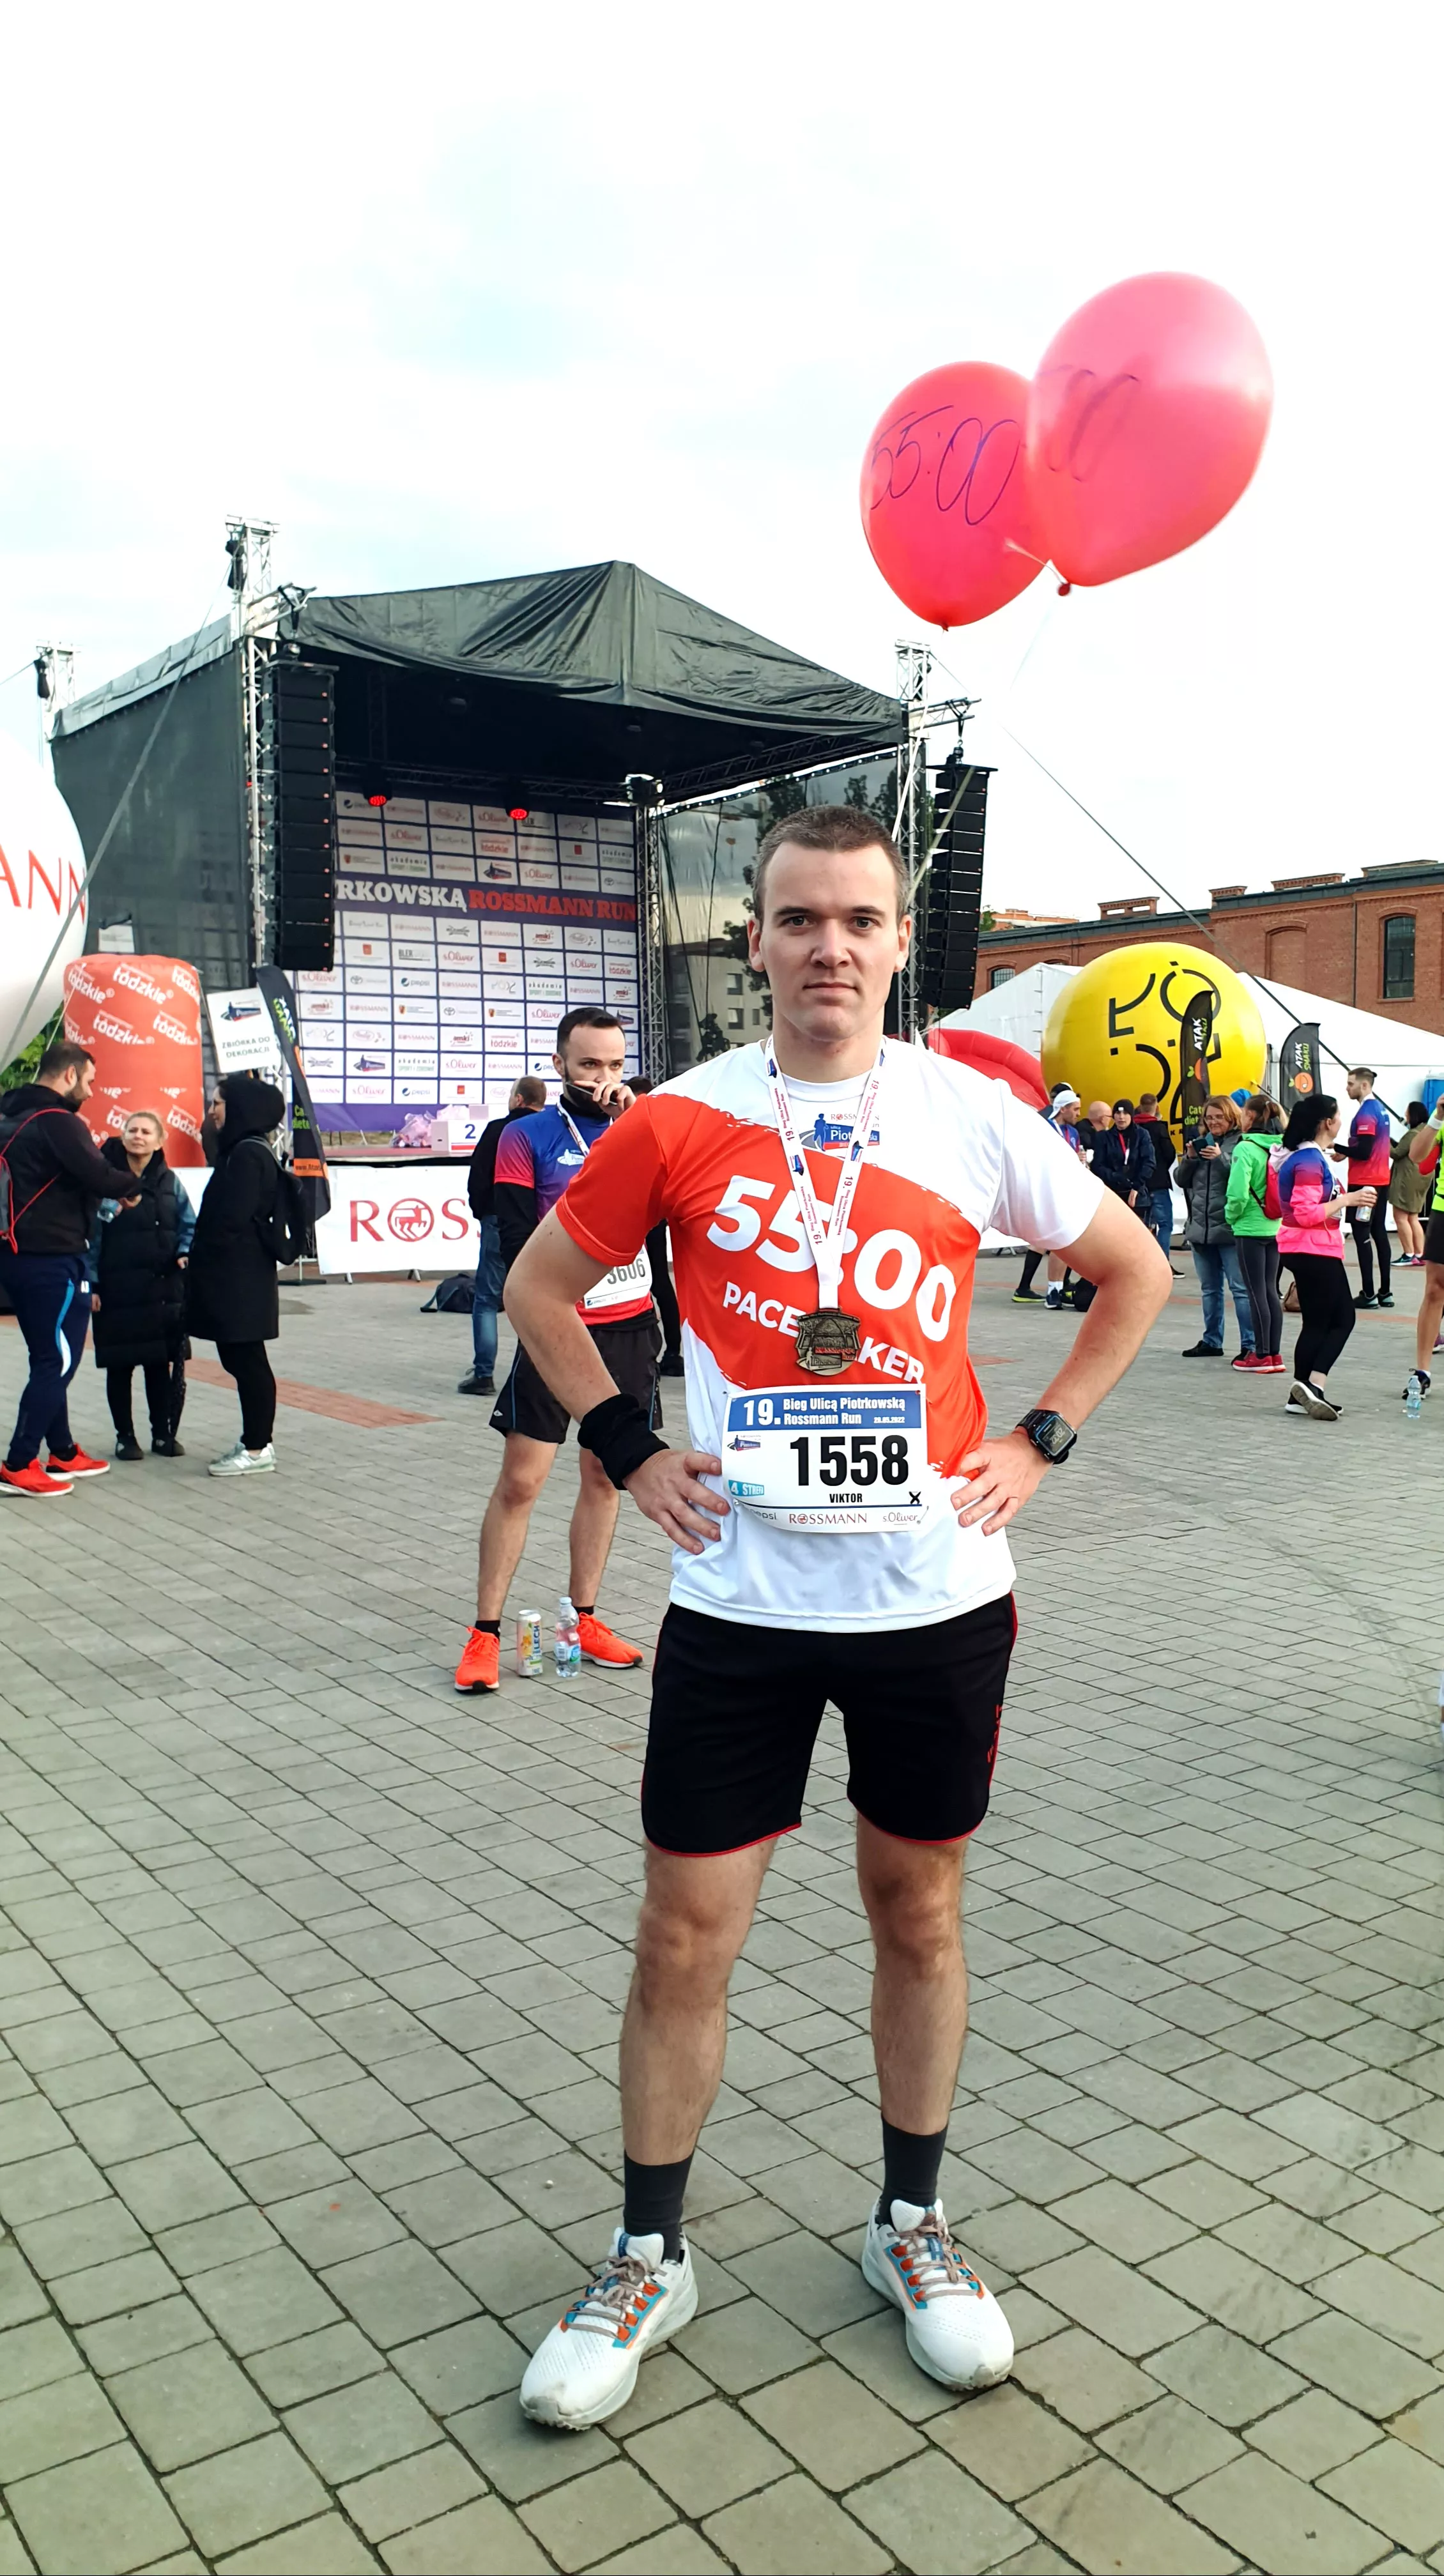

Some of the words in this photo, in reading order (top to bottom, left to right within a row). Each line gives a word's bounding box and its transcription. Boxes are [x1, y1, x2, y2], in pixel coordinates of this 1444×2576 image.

[335, 879, 467, 914] RKOWSKĄ
[468, 889, 594, 918] ROSSMANN
[597, 901, 636, 921] RUN
[1192, 1018, 1202, 1051] ATAK
[1294, 1042, 1303, 1069] ATAK
[465, 1124, 476, 1139] 2
[350, 1198, 480, 1242] ROS
[707, 1175, 956, 1342] 55:00
[722, 1281, 926, 1384] PACEKER
[743, 1398, 781, 1426] 19.
[783, 1398, 807, 1411] Bieg
[810, 1397, 838, 1412] Ulicą
[840, 1397, 905, 1411] Piotrkowską
[784, 1413, 838, 1425] Rossmann
[841, 1413, 862, 1424] Run
[790, 1434, 909, 1487] 1558
[730, 1482, 739, 1495] 4
[829, 1493, 863, 1503] VIKTOR
[789, 1513, 868, 1524] ROSSMANN
